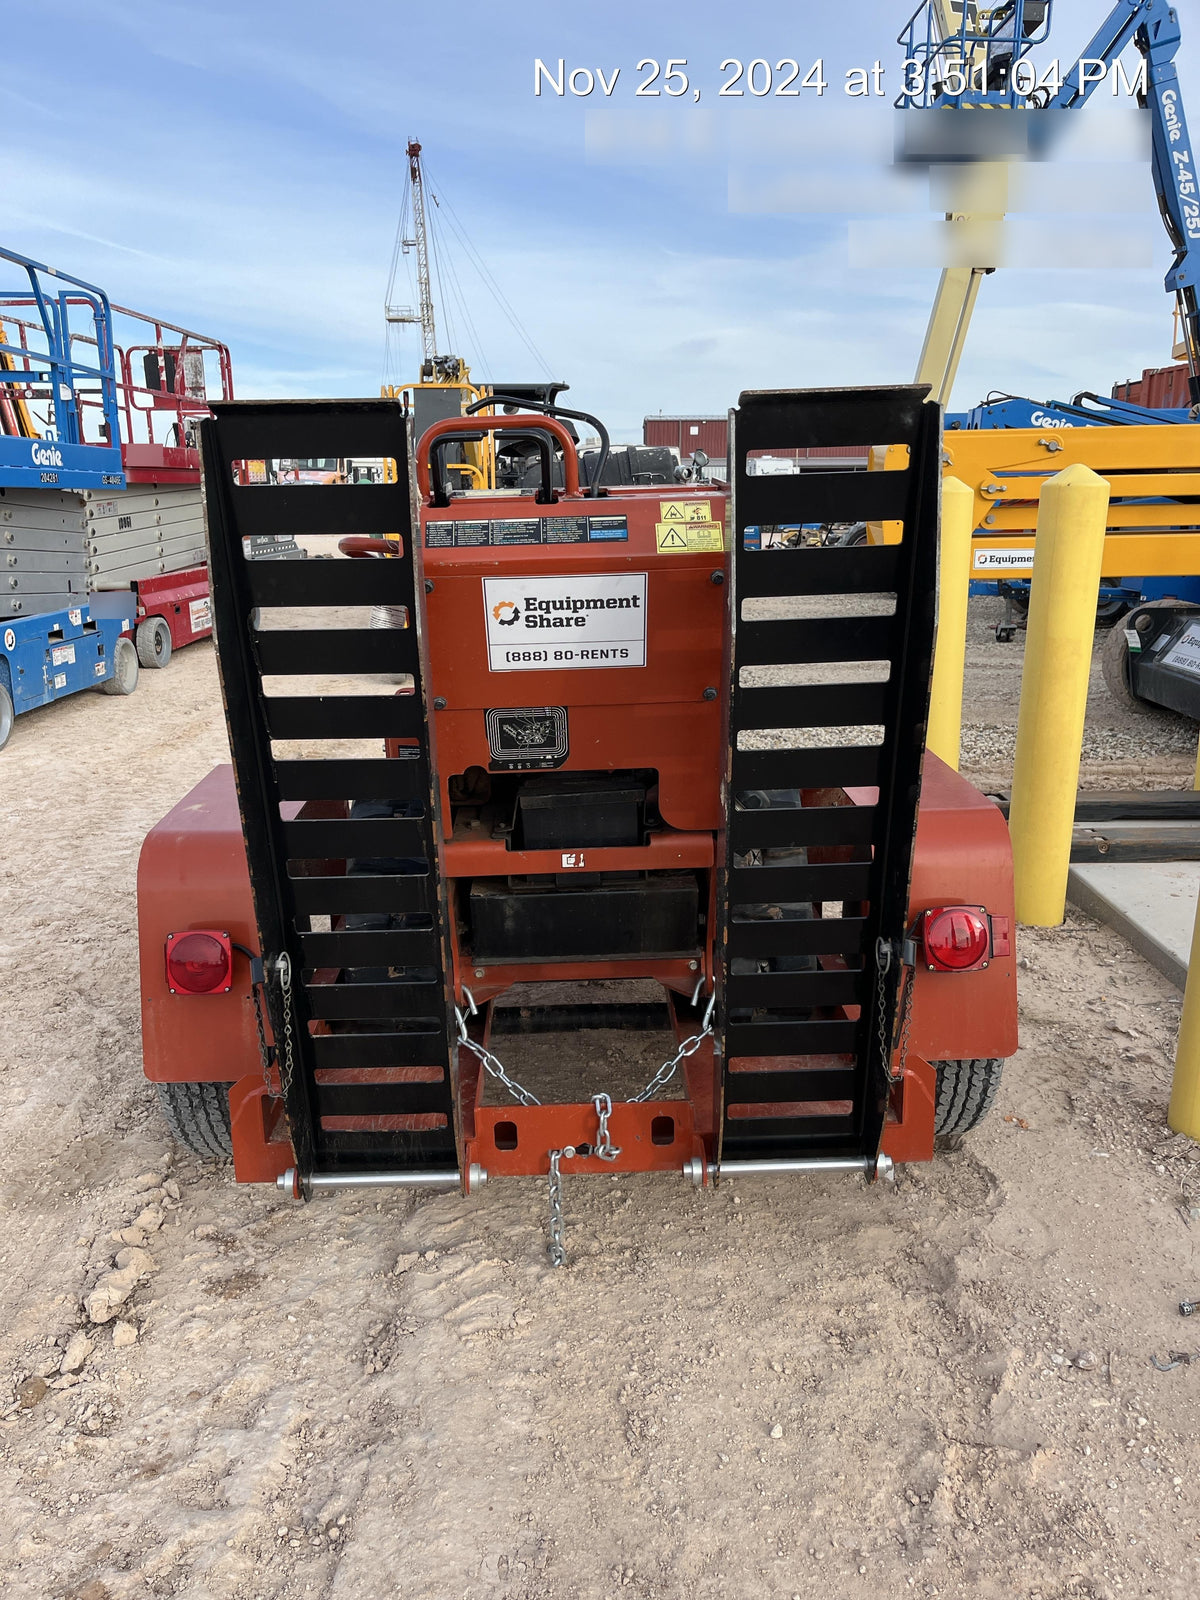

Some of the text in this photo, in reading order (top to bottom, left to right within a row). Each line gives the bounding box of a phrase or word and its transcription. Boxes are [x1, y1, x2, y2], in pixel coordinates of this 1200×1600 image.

[1161, 88, 1182, 143] Genie
[1172, 150, 1200, 239] Z-45/25J
[31, 442, 64, 466] Genie
[524, 595, 641, 614] Equipment
[524, 614, 588, 629] Share
[506, 648, 630, 663] (888) 80-RENTS
